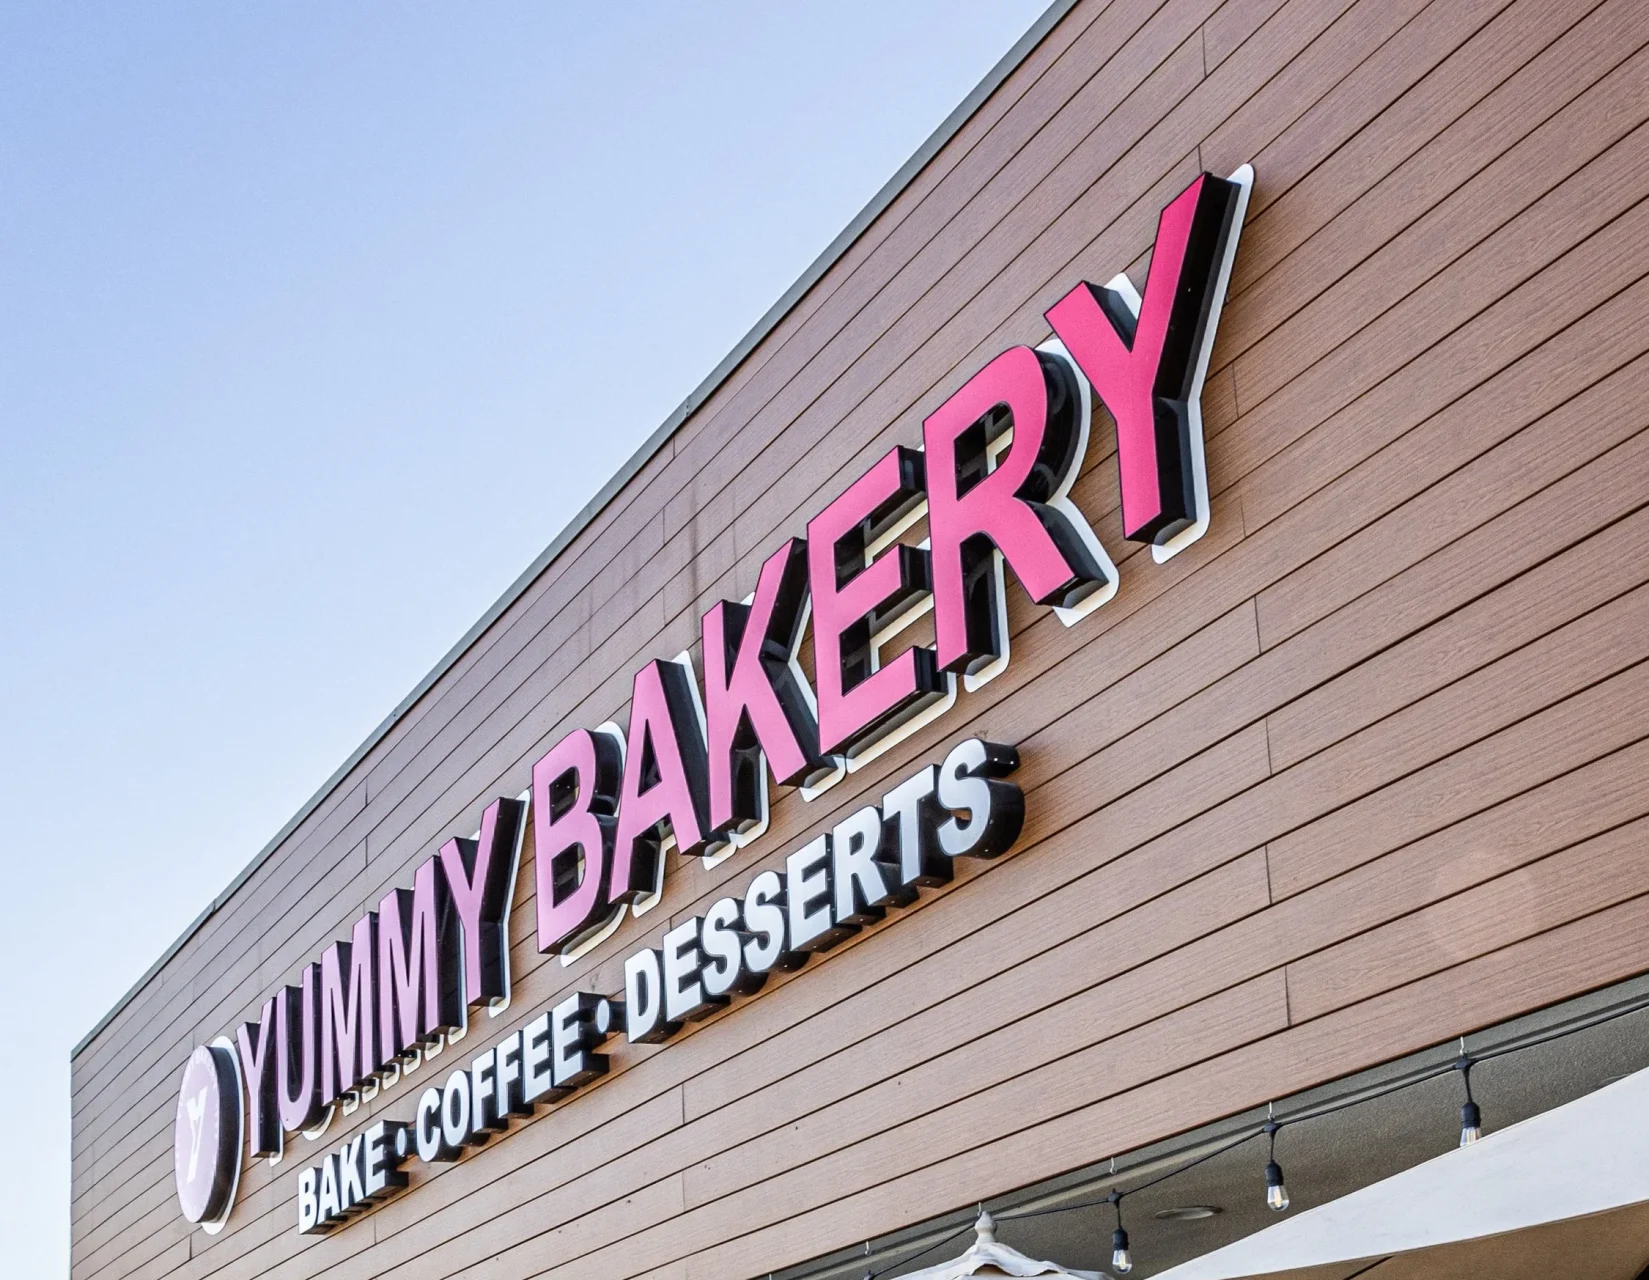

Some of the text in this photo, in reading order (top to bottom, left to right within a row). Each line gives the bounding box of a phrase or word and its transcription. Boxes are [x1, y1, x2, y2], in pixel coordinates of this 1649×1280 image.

[236, 172, 1209, 1158] YUMMY BAKERY
[298, 738, 994, 1235] BAKE COFFEE DESSERTS
